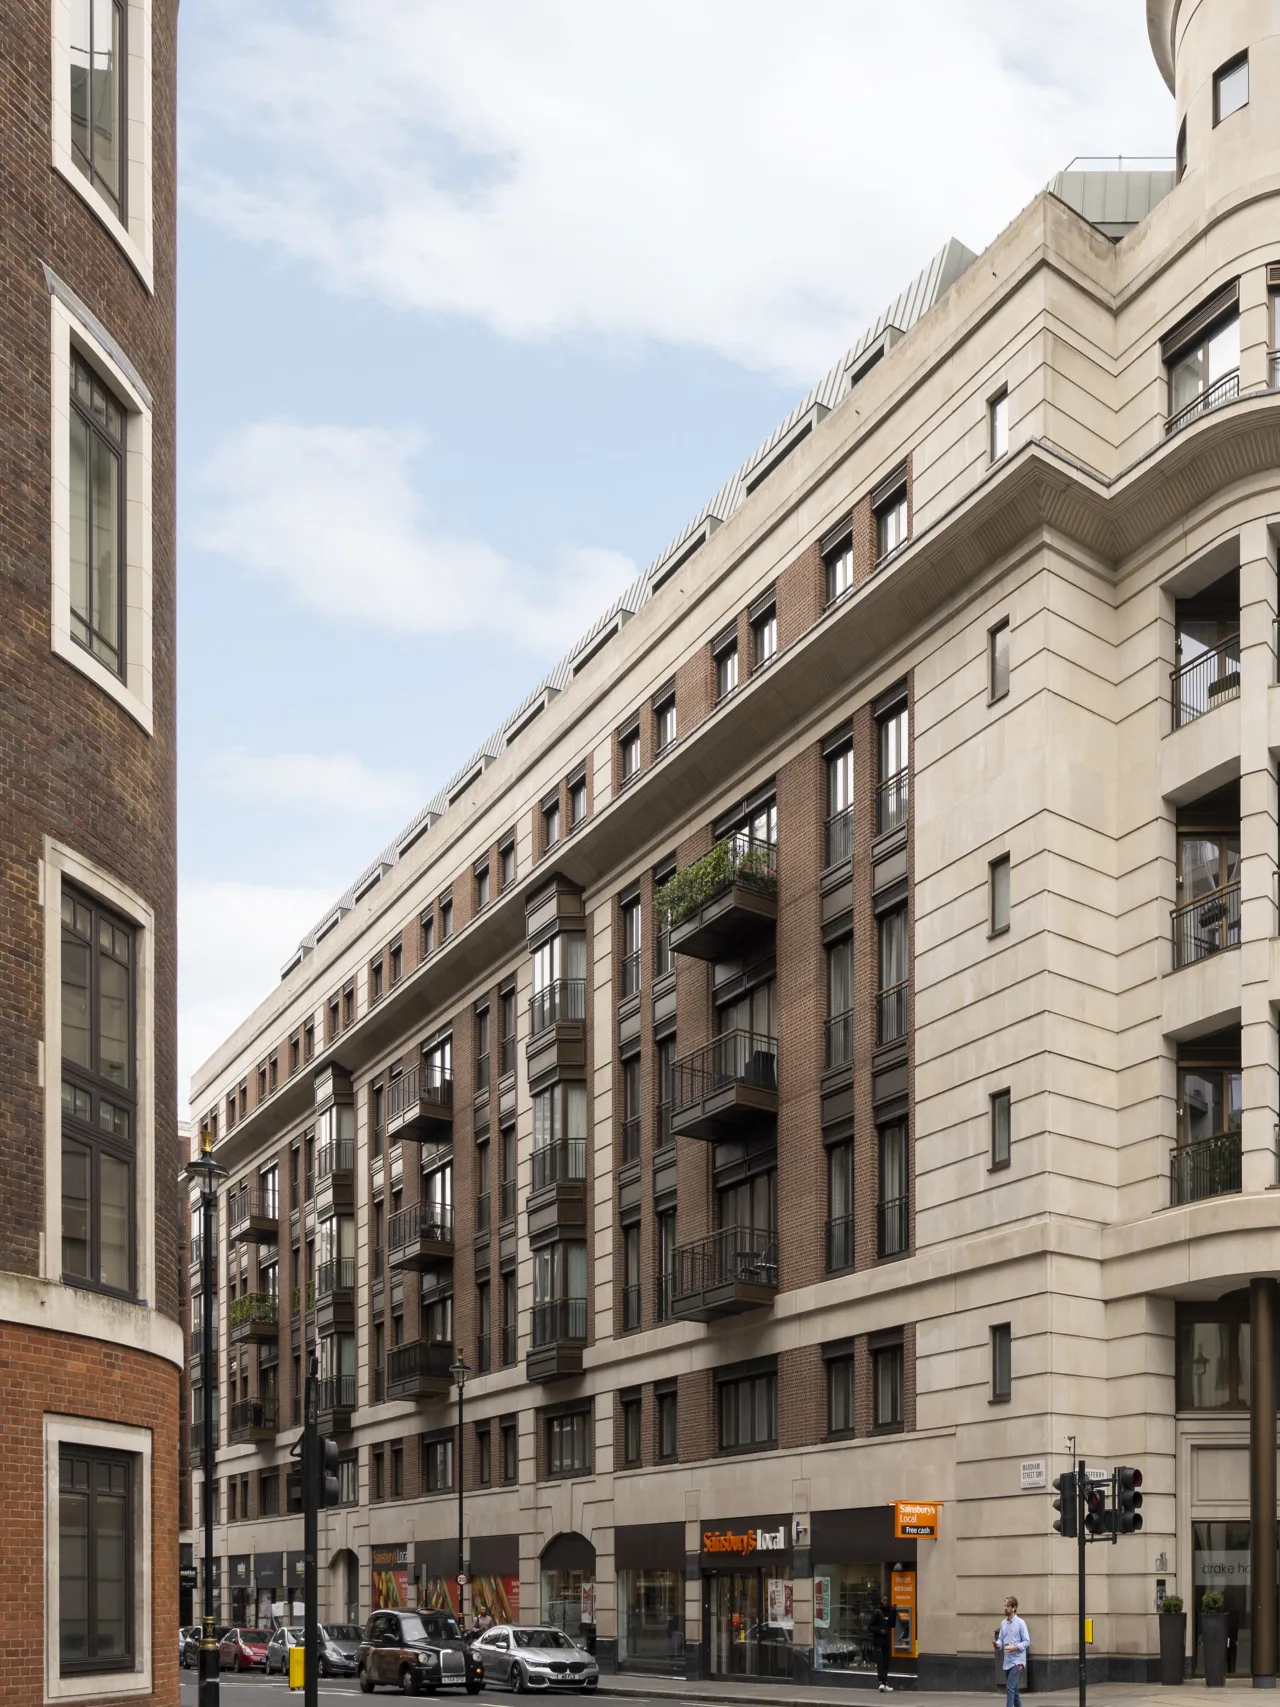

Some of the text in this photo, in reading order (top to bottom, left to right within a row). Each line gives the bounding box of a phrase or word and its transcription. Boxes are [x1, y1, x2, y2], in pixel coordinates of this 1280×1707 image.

[1022, 1471, 1035, 1480] STREET
[900, 1504, 936, 1516] Sainsbury's
[900, 1514, 917, 1523] Local
[905, 1526, 931, 1534] Free cash
[703, 1529, 757, 1556] Sainsbury's
[373, 1549, 408, 1567] Sainsbury's Loca
[1202, 1562, 1235, 1575] drake
